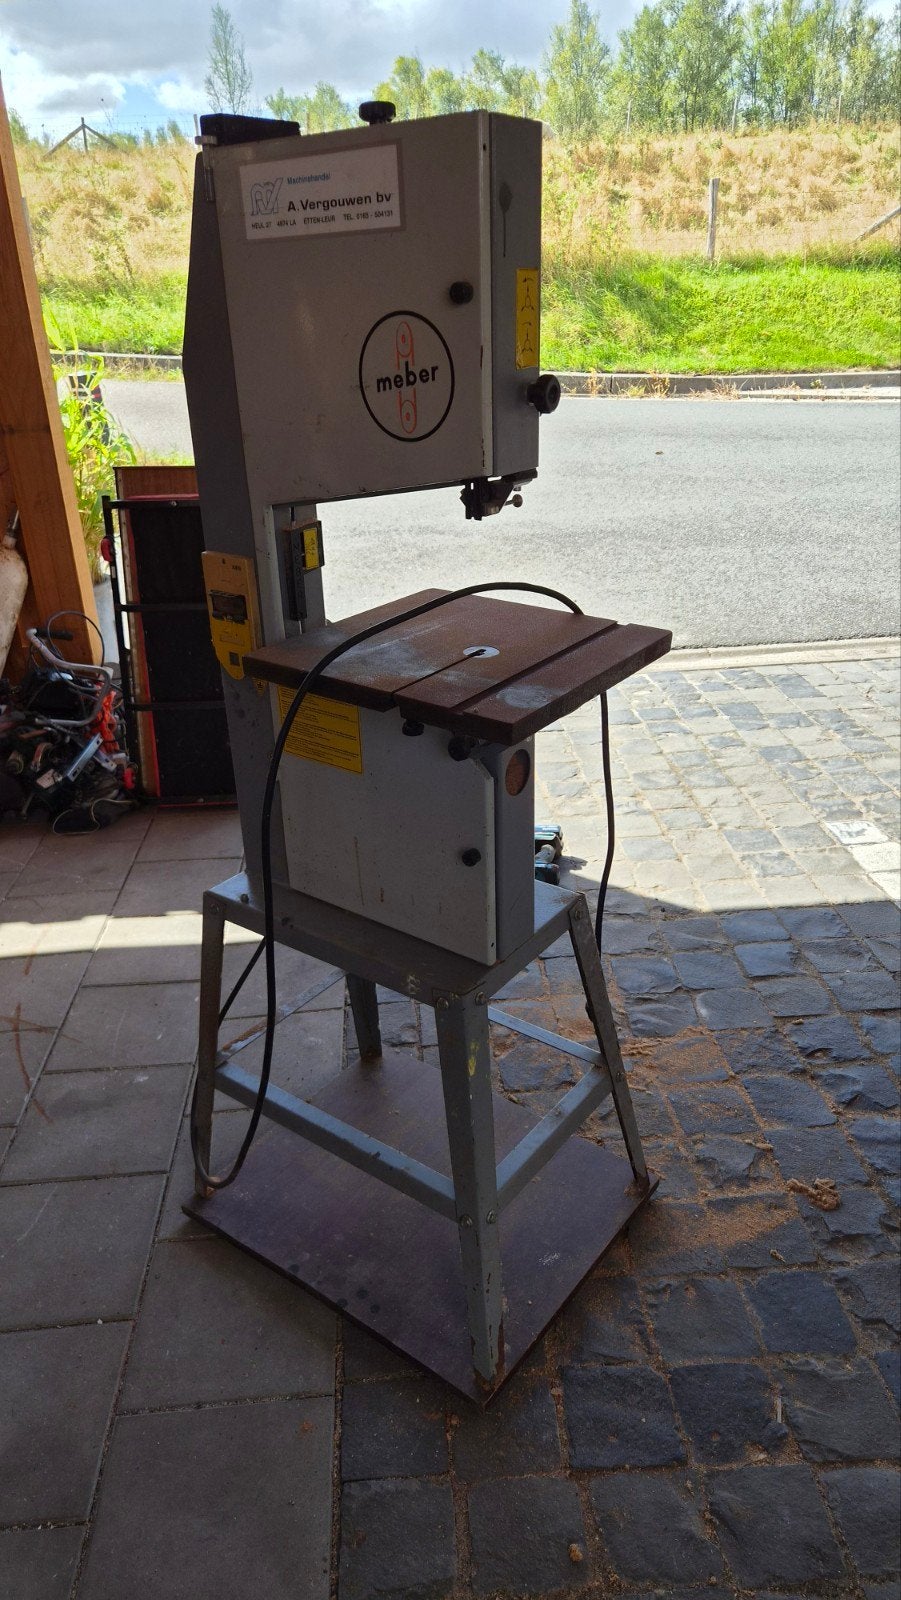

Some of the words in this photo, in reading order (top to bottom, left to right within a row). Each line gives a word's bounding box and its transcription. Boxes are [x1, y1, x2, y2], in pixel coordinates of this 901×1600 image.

[376, 192, 392, 203] bv
[303, 215, 336, 225] ETTEN-LEUR
[376, 361, 439, 393] meber
